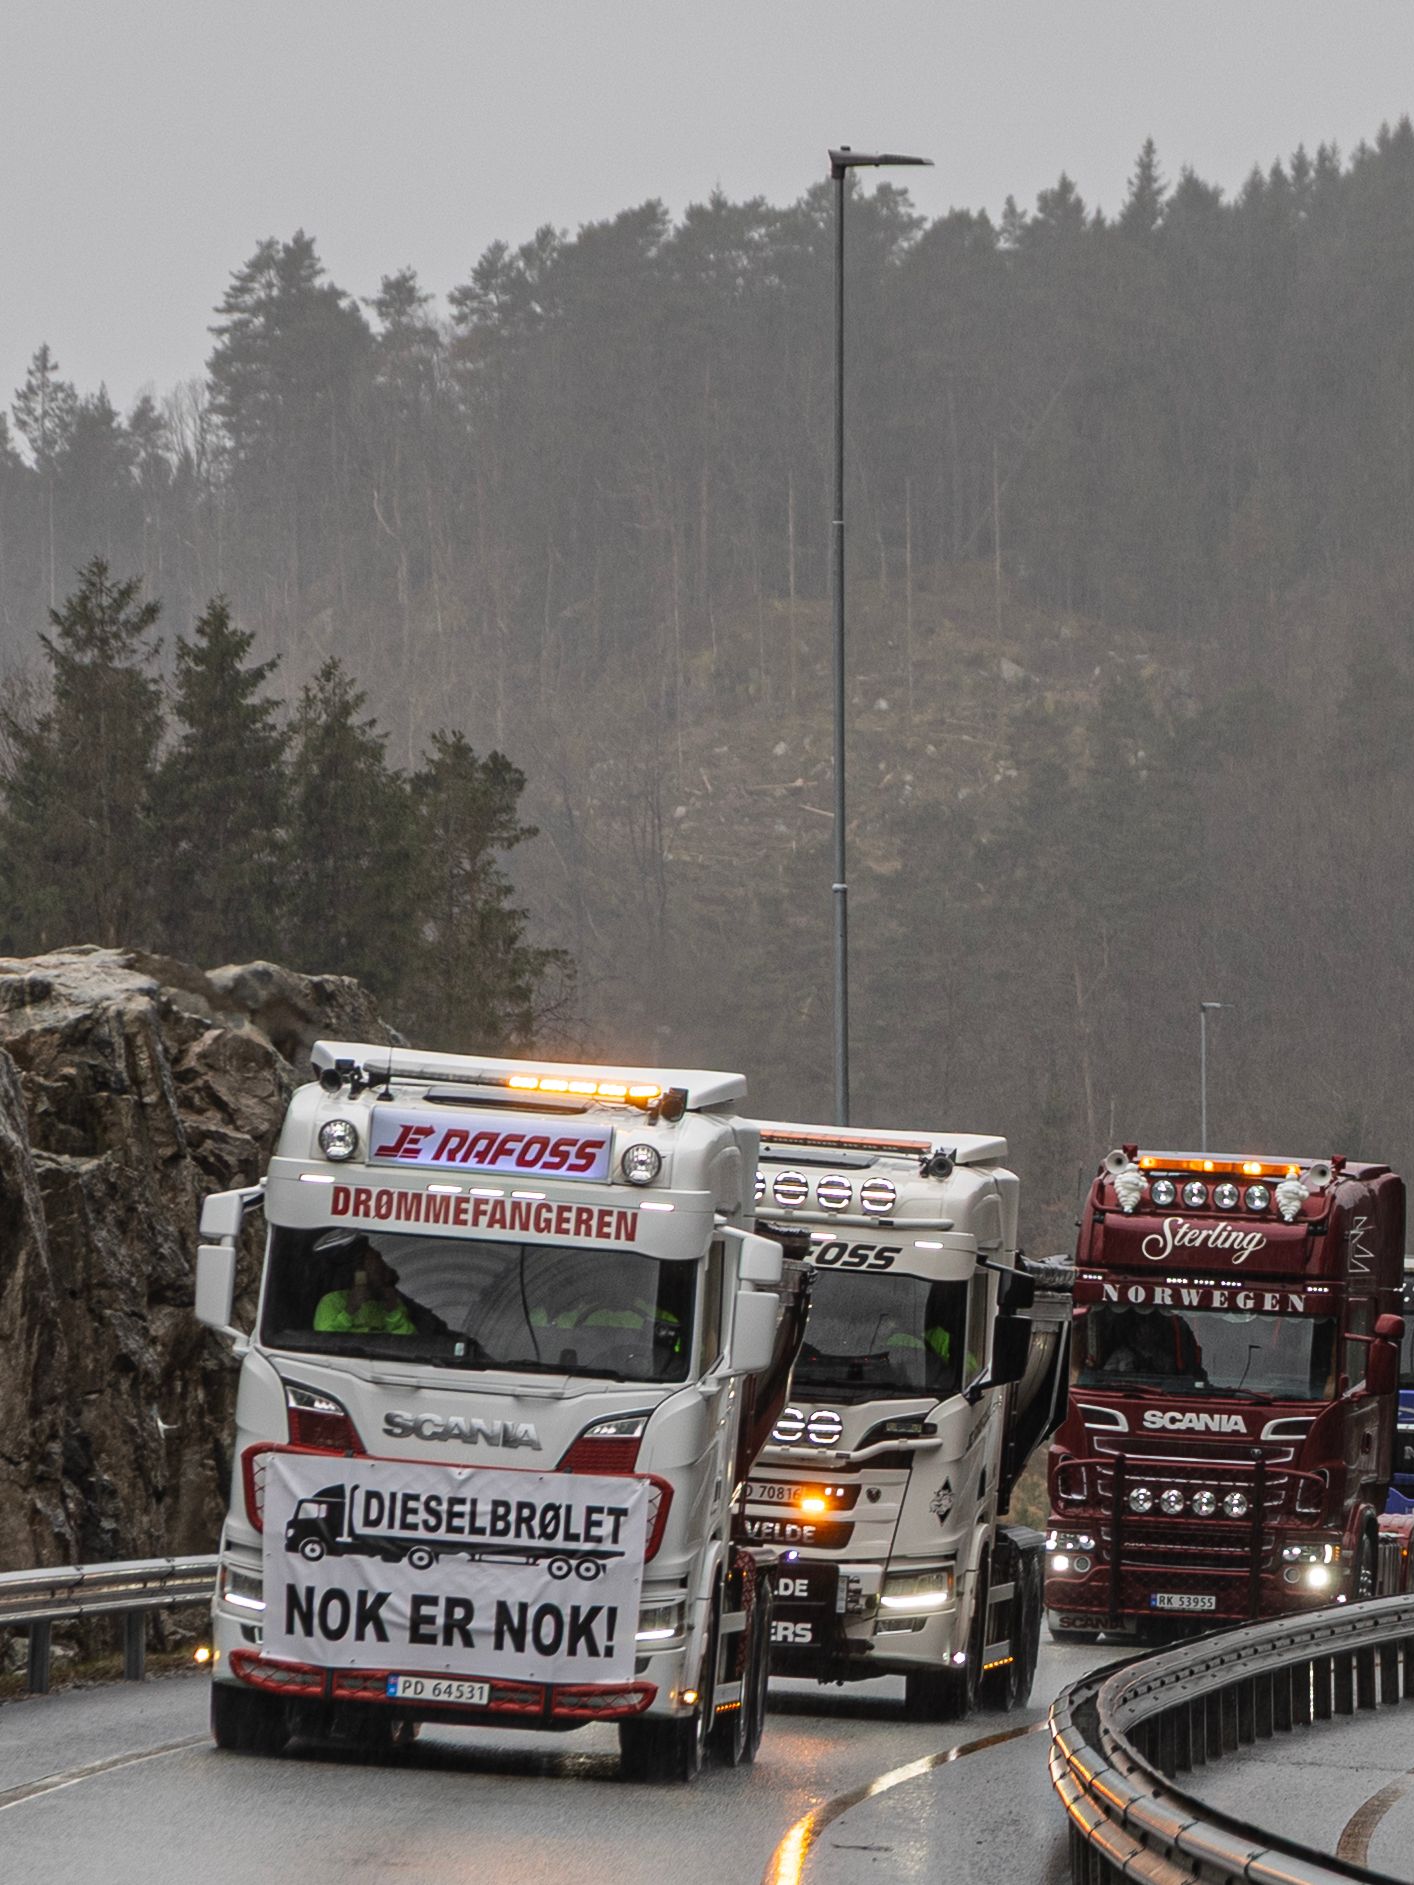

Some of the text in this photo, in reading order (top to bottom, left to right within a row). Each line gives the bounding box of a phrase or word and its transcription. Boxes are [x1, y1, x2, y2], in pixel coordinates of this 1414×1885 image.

[431, 1128, 605, 1173] RAFOSS
[330, 1185, 639, 1242] DRØMMEFANGEREN
[1142, 1216, 1267, 1265] Sterling
[1101, 1283, 1306, 1313] NORWEGEN
[382, 1410, 543, 1451] SCANIA
[1142, 1410, 1248, 1433] SCANIA
[759, 1485, 801, 1501] 70816
[361, 1490, 629, 1545] DIESELBRØLET
[744, 1519, 817, 1544] VELDE
[1158, 1596, 1214, 1608] RK 53955
[285, 1583, 619, 1659] NOK ER NOK!
[1058, 1615, 1127, 1630] SCANIA
[402, 1679, 485, 1701] PD 64531
